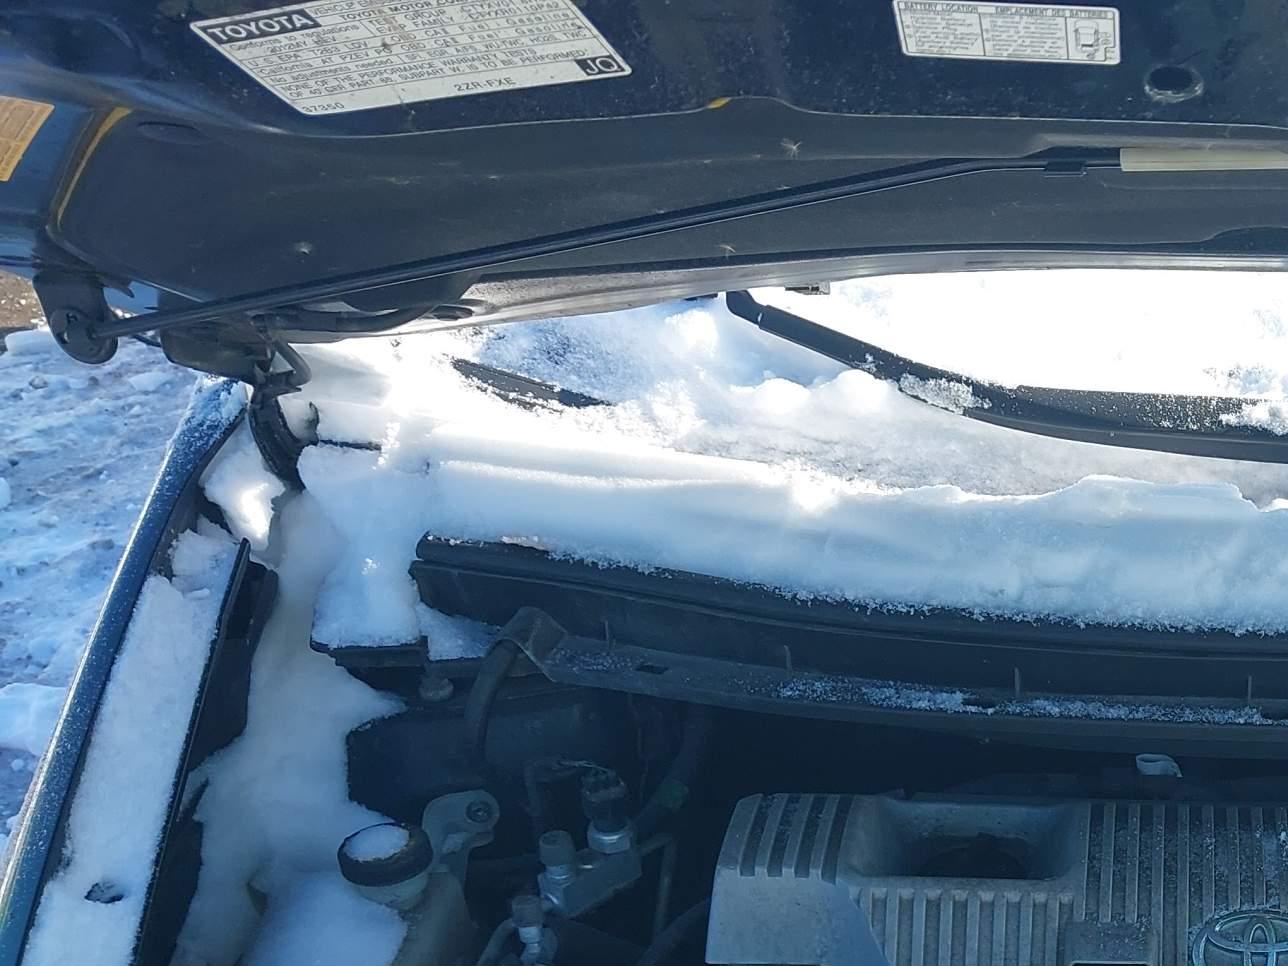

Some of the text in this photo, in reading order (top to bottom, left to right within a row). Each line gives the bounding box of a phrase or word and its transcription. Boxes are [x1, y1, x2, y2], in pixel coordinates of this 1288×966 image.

[339, 9, 385, 20] TOYOTA
[389, 2, 431, 11] MOTOR
[403, 9, 447, 20] GROUP
[206, 14, 315, 40] TOYOTA
[412, 17, 456, 28] FAMILY
[266, 42, 309, 51] 2012MY
[279, 83, 313, 91] NONE
[356, 62, 439, 78] PERFORMANCE
[441, 53, 500, 65] WARRANTY
[397, 68, 447, 79] SUBPART
[453, 57, 621, 91] 2ZR-FXE JQ
